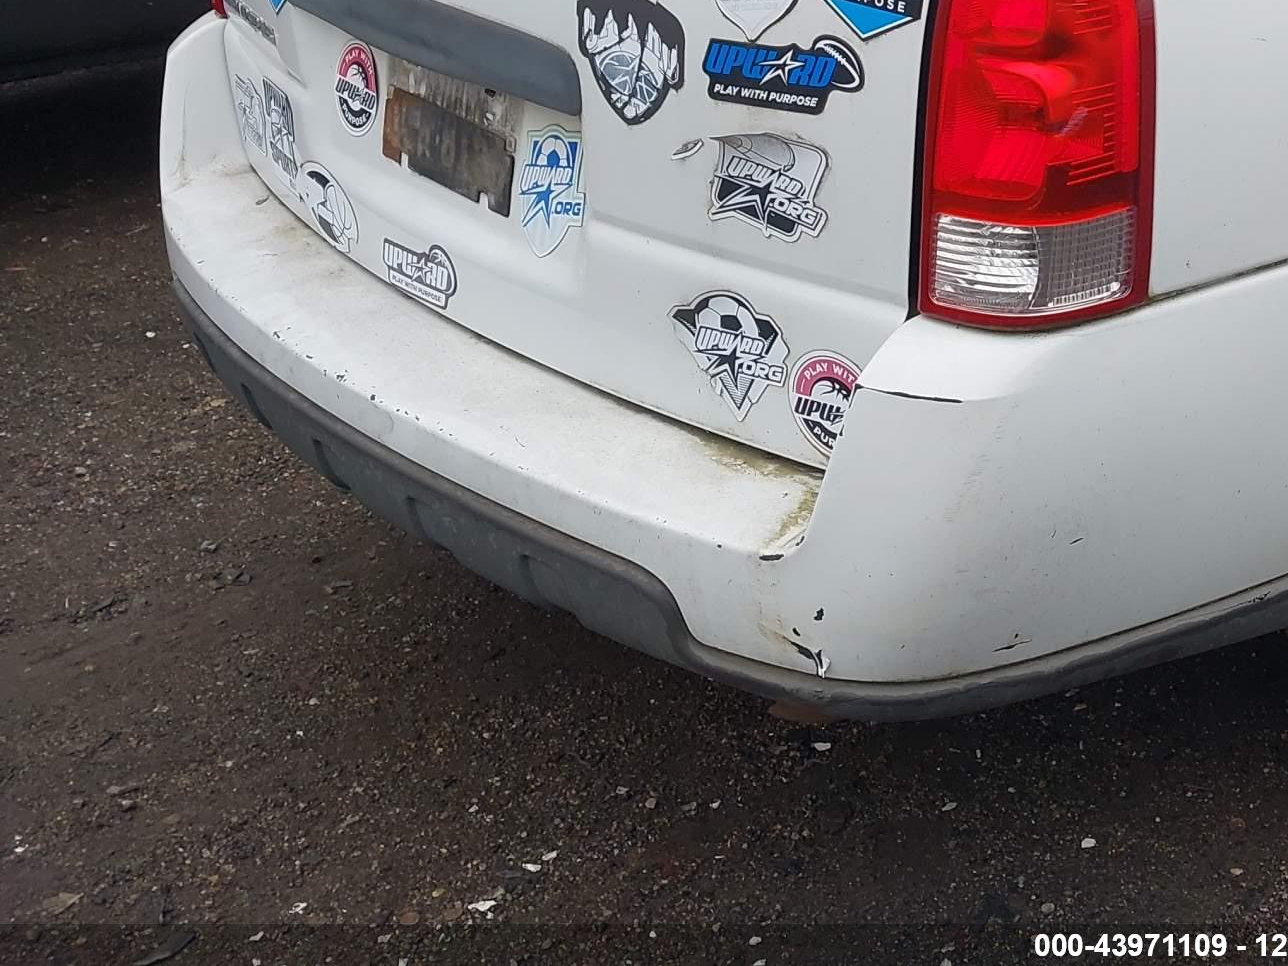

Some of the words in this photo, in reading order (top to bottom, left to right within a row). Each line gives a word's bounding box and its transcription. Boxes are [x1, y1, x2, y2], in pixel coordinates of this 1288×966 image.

[714, 84, 739, 96] PLAY
[741, 88, 767, 100] WITH
[769, 92, 818, 107] PURPOSE
[520, 166, 572, 192] UPWARD
[727, 155, 804, 196] UPWARD
[552, 202, 581, 217] .ORG
[769, 197, 819, 226] .ORG
[696, 326, 765, 356] UPWARD
[738, 360, 784, 383] .ORG
[804, 362, 828, 380] PLAY
